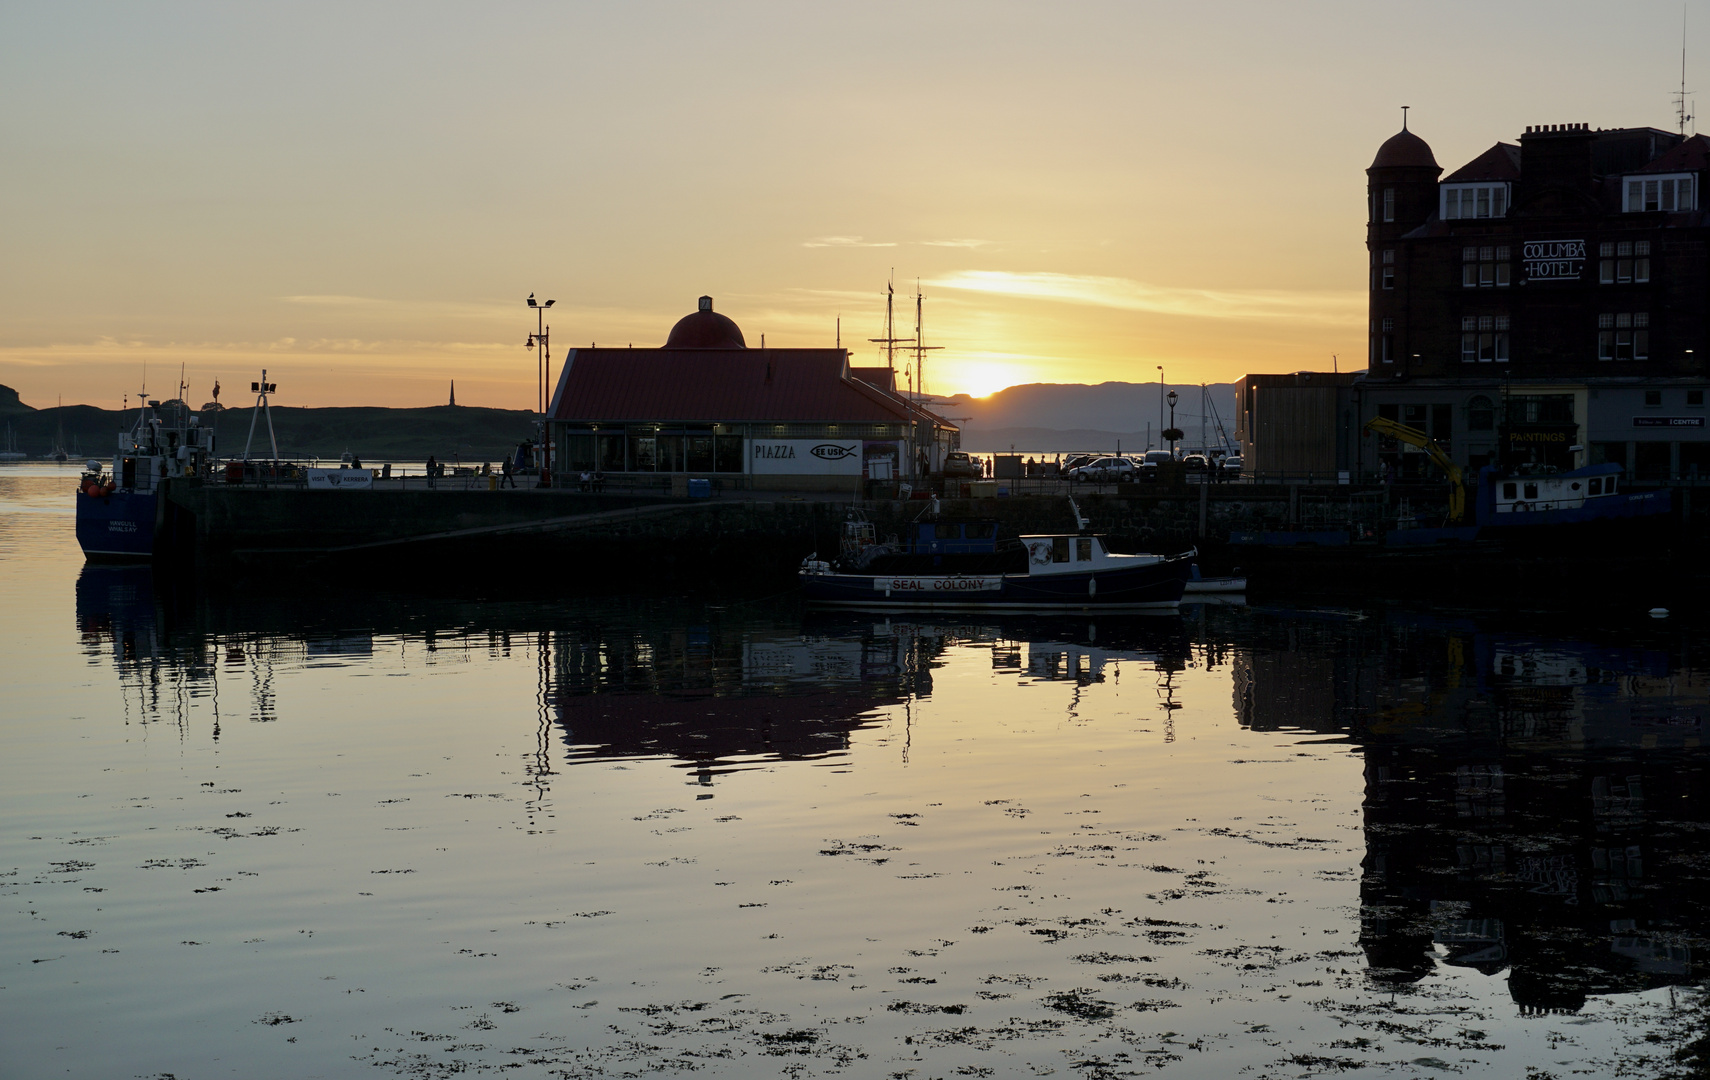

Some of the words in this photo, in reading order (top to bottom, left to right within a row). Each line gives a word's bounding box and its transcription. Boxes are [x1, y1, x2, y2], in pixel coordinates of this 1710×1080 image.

[1523, 242, 1587, 258] COLUMBA
[1530, 261, 1580, 277] HOTEL
[1509, 432, 1566, 443] PAINTINGS
[755, 445, 796, 459] PIAZZA
[815, 448, 826, 456] EE
[827, 447, 845, 456] USK
[893, 579, 925, 590] SEAL
[933, 579, 985, 590] COLONY
